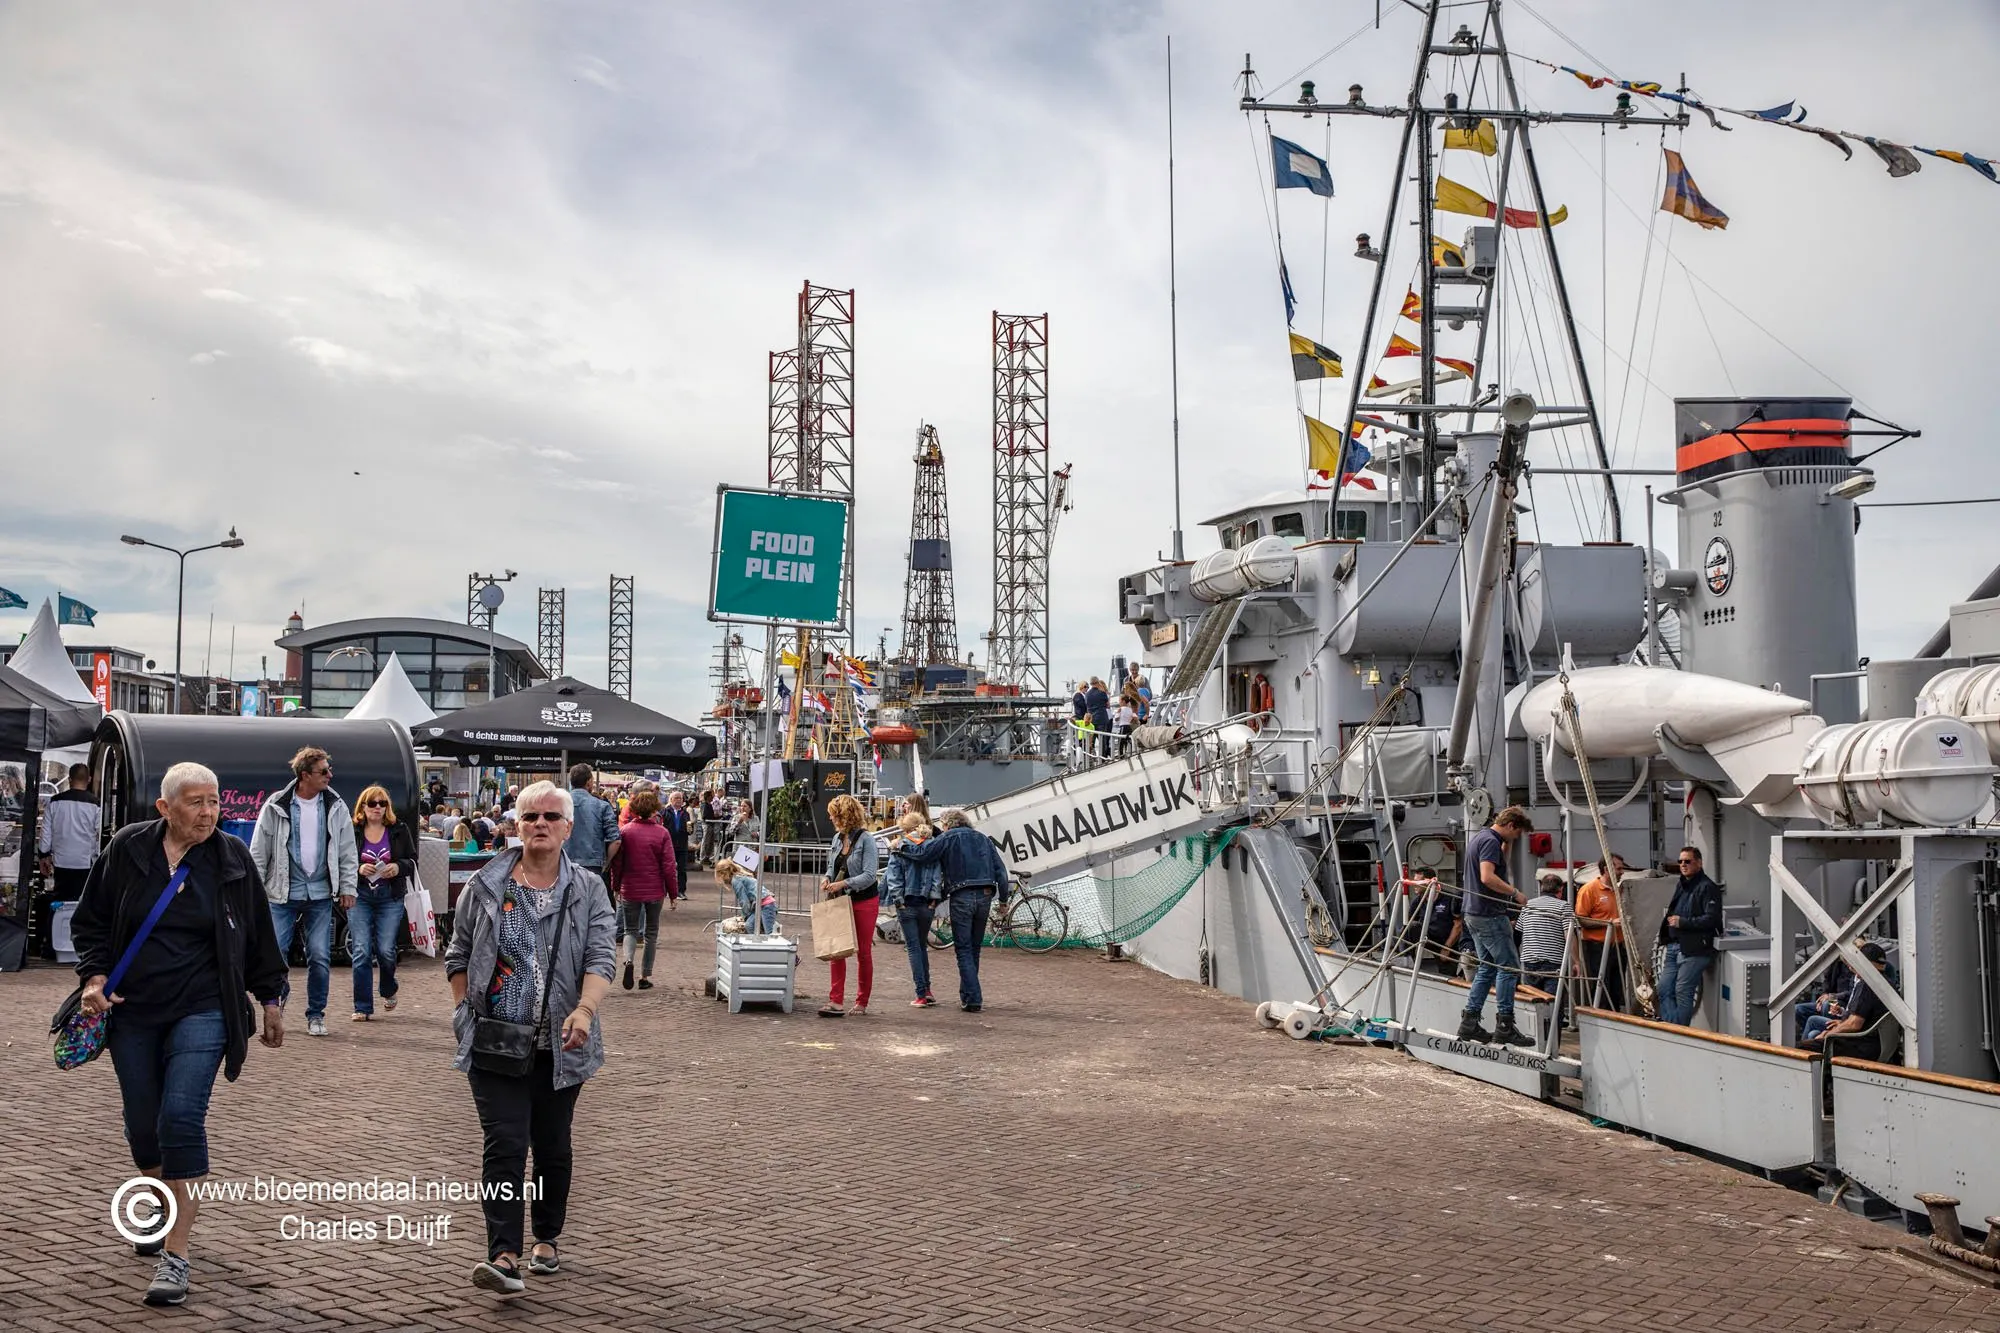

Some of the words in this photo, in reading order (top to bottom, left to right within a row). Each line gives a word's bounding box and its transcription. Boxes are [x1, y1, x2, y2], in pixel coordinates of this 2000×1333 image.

[1713, 510, 1723, 528] 32
[750, 530, 815, 557] FOOD
[745, 557, 815, 584] PLEIN
[541, 709, 593, 718] RUHR
[541, 715, 593, 723] GOLD
[463, 730, 474, 738] De
[475, 730, 499, 741] échte
[499, 733, 527, 743] smaak
[527, 736, 542, 744] van
[543, 736, 559, 745] pils
[590, 736, 616, 748] Puur
[220, 788, 265, 810] Korf
[1447, 1042, 1471, 1056] MAX
[1473, 1047, 1500, 1061] LOAD
[1506, 1053, 1526, 1067] 850
